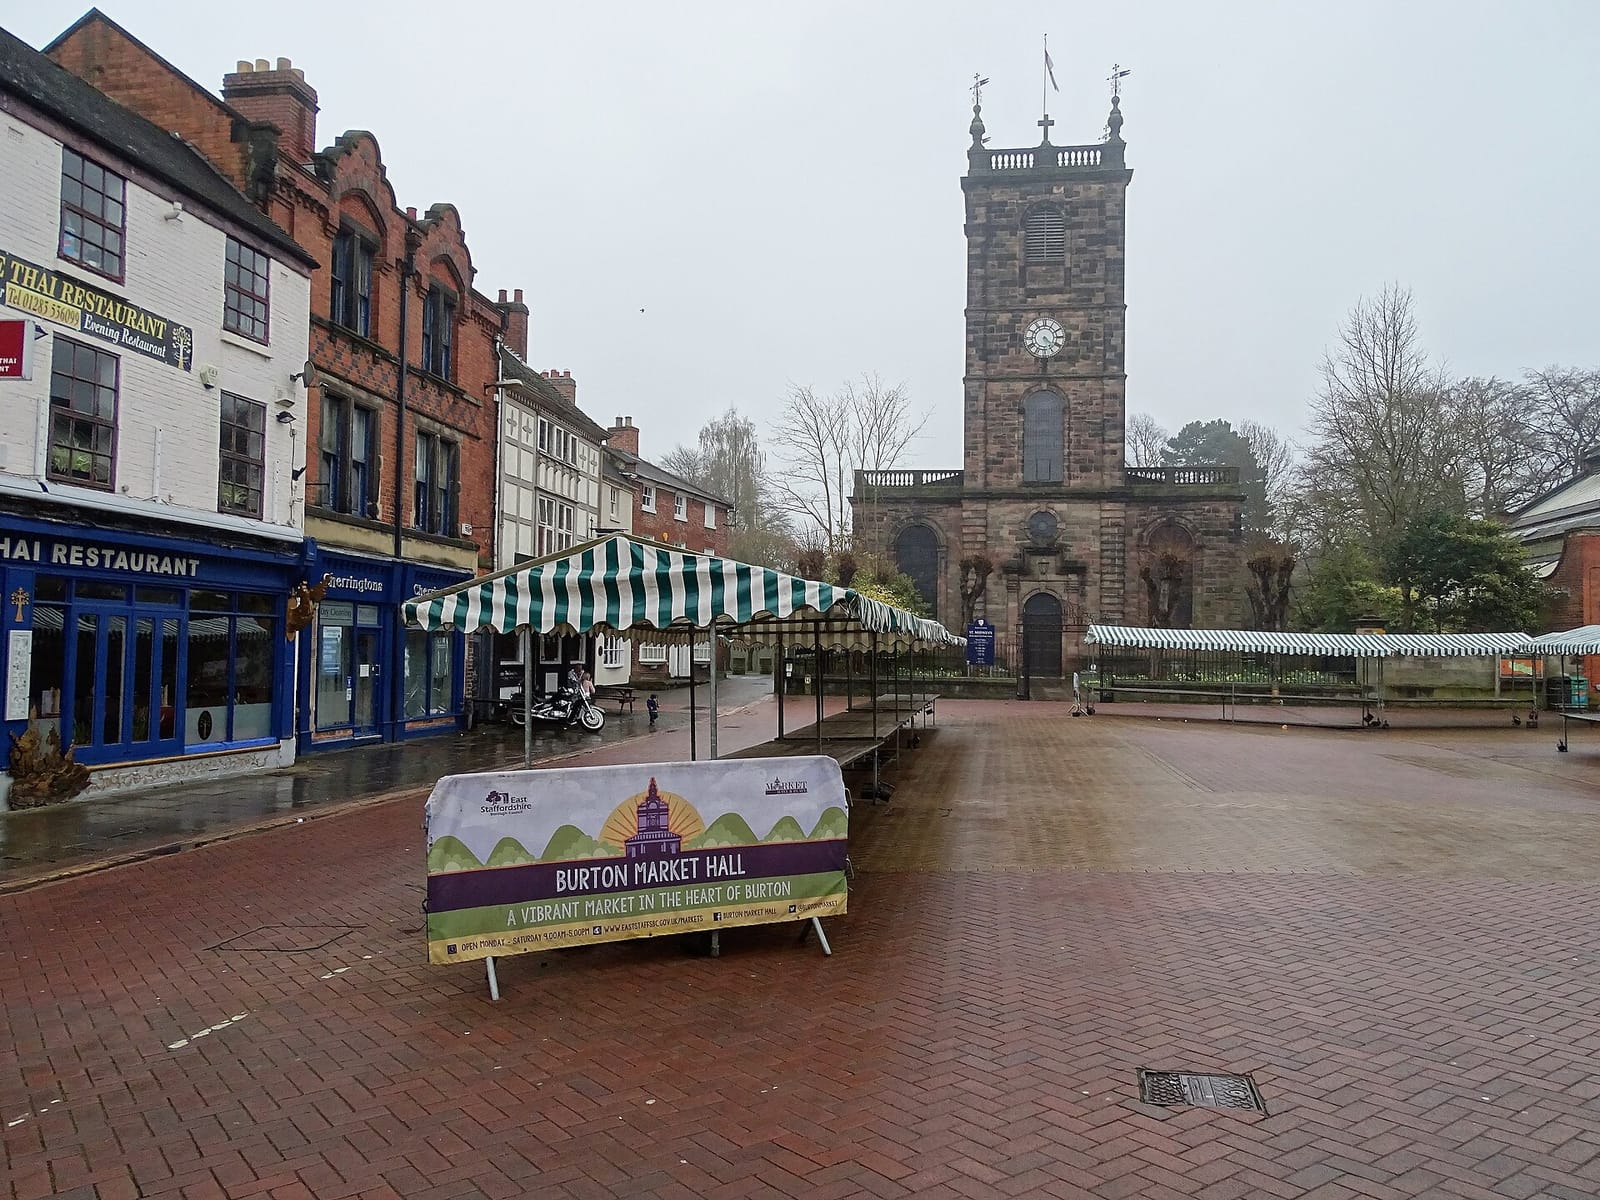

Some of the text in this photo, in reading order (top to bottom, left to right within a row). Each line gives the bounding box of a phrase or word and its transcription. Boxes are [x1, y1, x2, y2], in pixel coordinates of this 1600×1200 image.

[8, 287, 22, 305] Tel
[10, 260, 58, 297] THAI
[60, 280, 167, 340] RESTAURANT
[84, 313, 166, 358] Evening Restaurant
[51, 543, 200, 577] RESTAURANT
[480, 803, 532, 813] Staffordshire
[510, 796, 528, 804] East
[556, 853, 746, 893] BURTON MARKET HALL
[506, 881, 791, 927] A VIBRANT MARKET IN THE HEART OF BURTON
[723, 907, 777, 919] BURTON MARKET HALL
[461, 941, 478, 951] OPEN
[479, 938, 506, 948] MONDAY
[512, 934, 542, 944] SATURDAY
